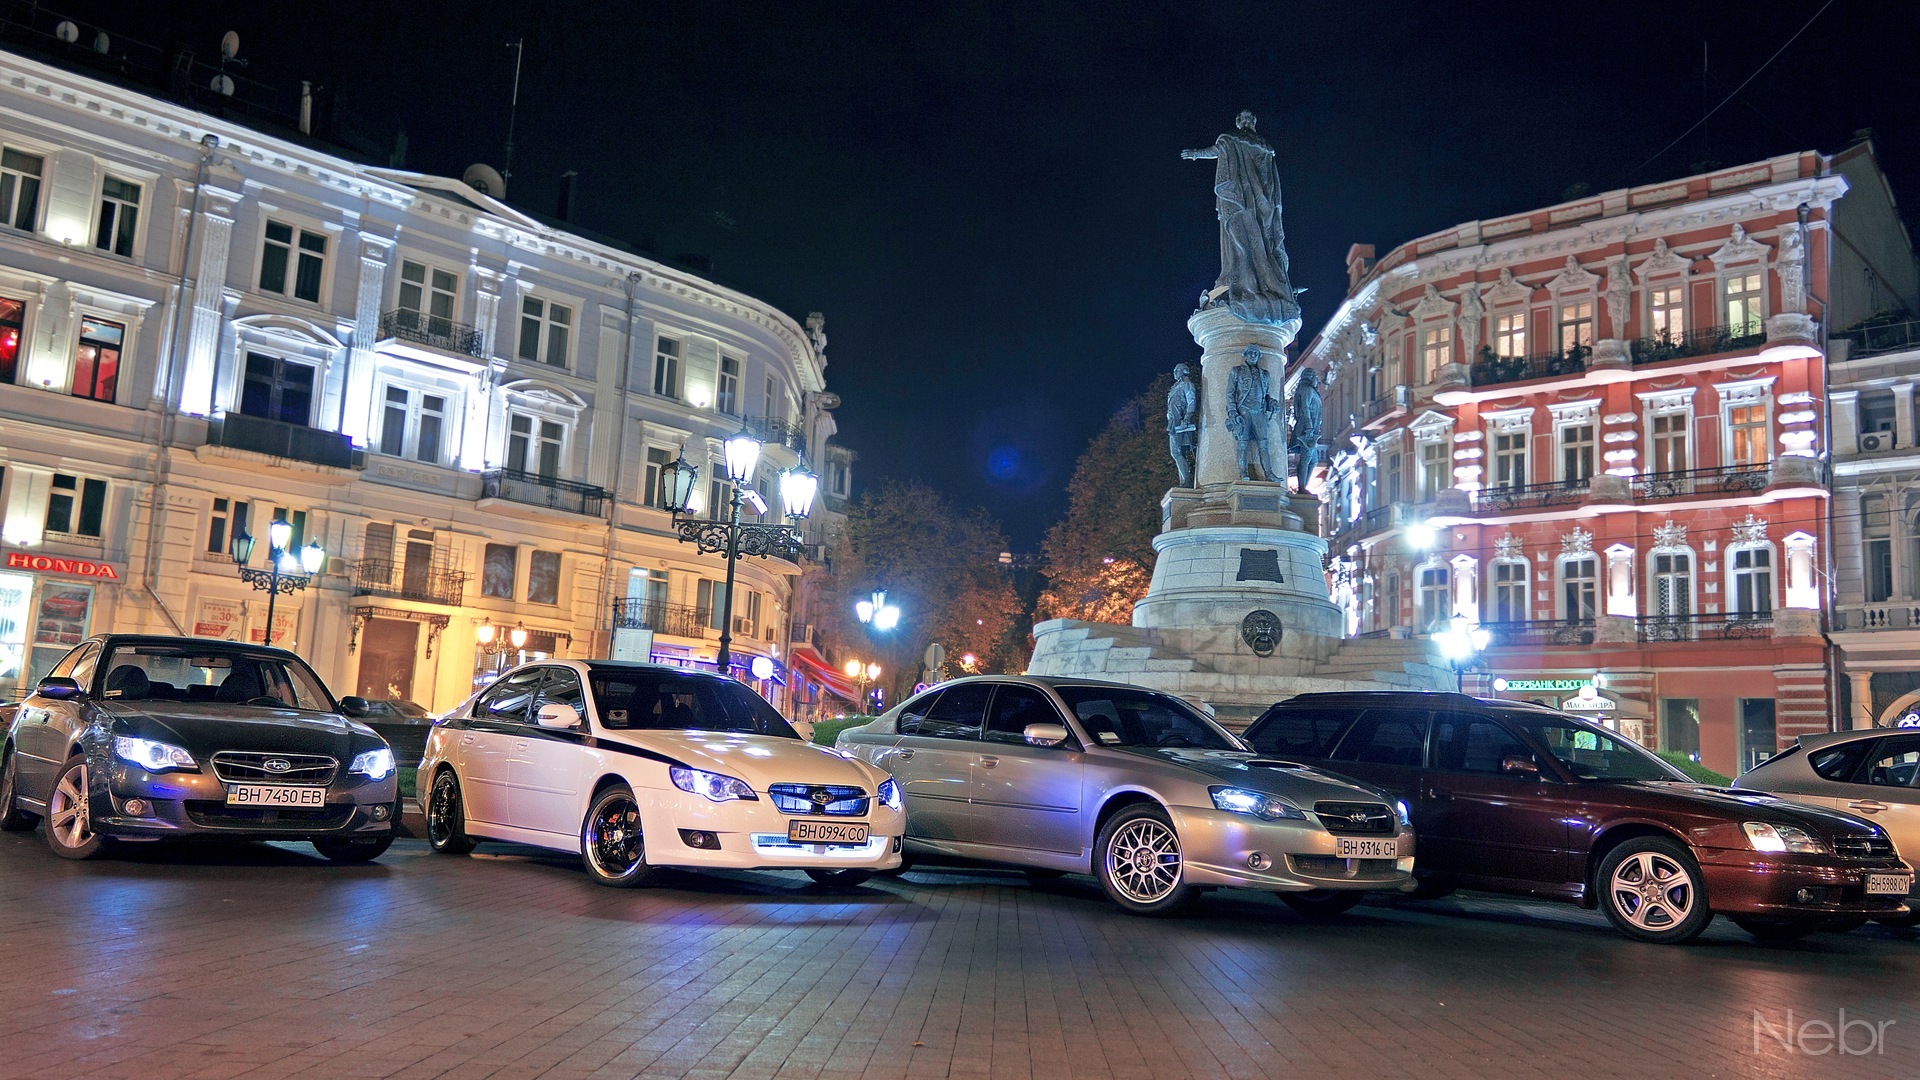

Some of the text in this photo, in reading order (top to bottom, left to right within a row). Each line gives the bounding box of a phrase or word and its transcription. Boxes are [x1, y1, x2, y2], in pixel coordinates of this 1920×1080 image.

[8, 552, 118, 578] HONDA
[219, 611, 239, 622] 30%
[1507, 680, 1554, 689] СБЕРБАНК
[238, 787, 322, 804] BH 7450 EB
[799, 824, 865, 841] BH 0994 CO
[1343, 840, 1396, 856] BH 9316 CH
[1871, 877, 1882, 891] BH
